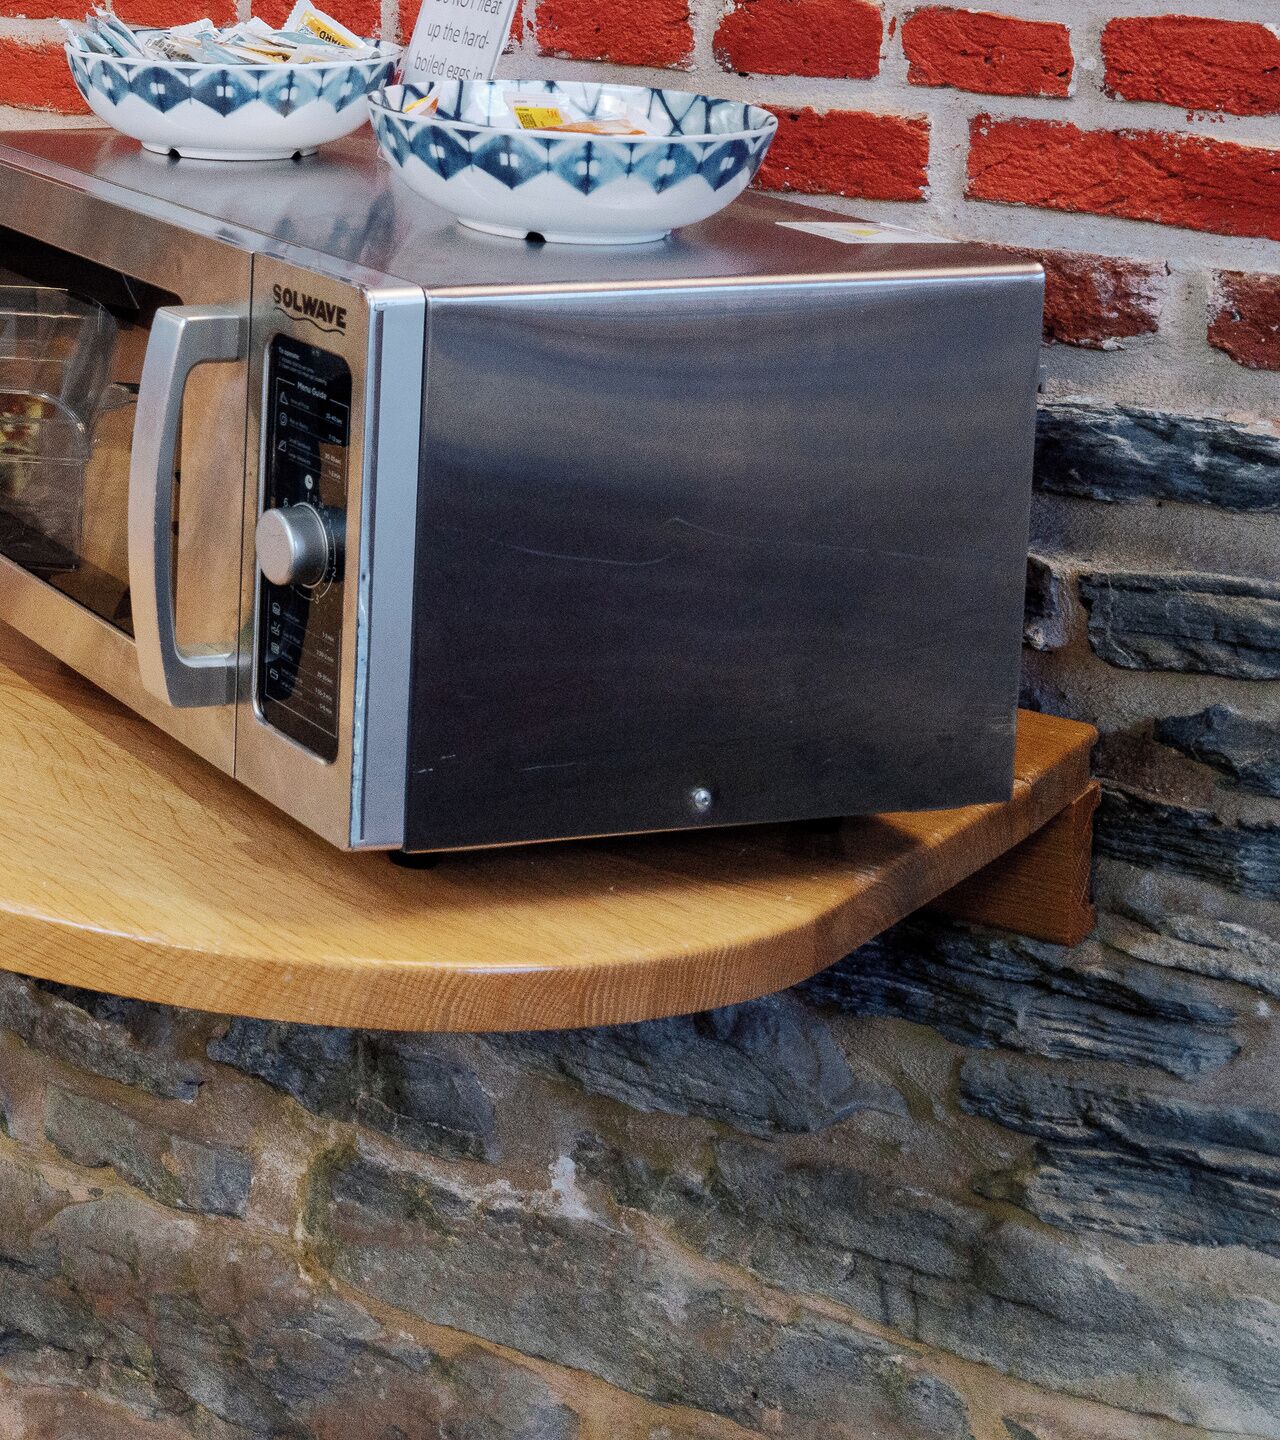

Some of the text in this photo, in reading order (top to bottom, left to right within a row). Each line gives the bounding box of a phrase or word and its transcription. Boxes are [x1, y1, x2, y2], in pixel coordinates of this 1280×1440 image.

[427, 22, 489, 49] up the hard-
[414, 51, 483, 80] boiled eggs in
[272, 283, 347, 329] SOLWAVE
[297, 381, 327, 400] Menu Guide
